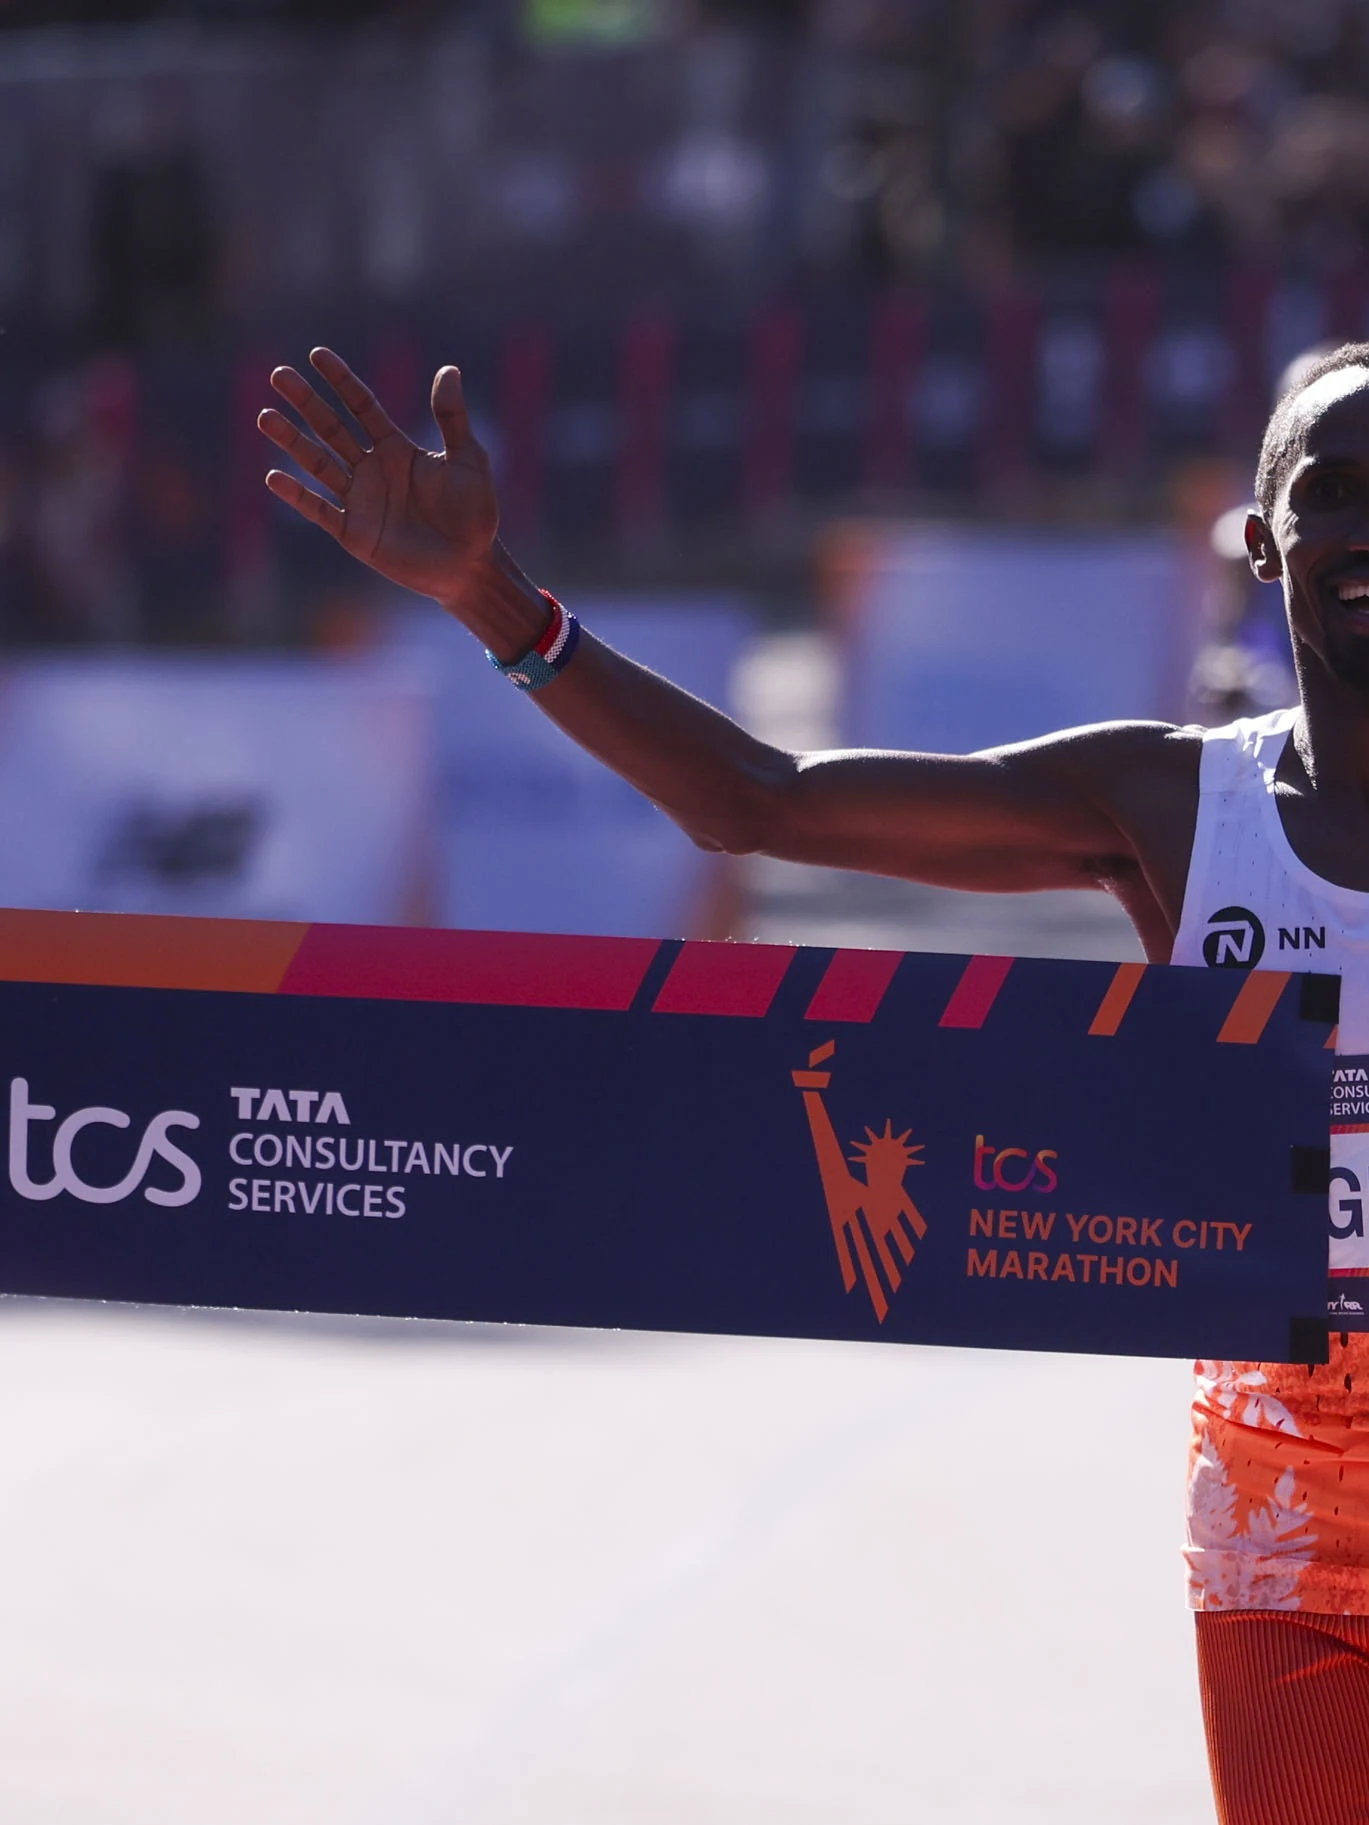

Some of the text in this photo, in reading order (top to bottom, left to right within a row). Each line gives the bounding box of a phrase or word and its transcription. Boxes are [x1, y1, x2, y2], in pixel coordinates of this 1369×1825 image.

[1278, 926, 1326, 950] NN
[1332, 1068, 1368, 1082] ATA
[230, 1087, 351, 1125] TATA
[9, 1077, 202, 1207] tcs
[228, 1131, 514, 1178] CONSULTANCY
[972, 1134, 1058, 1193] tcs
[227, 1177, 407, 1219] SERVICES
[969, 1208, 1253, 1252] NEW YORK CITY
[965, 1248, 1179, 1288] MARATHON
